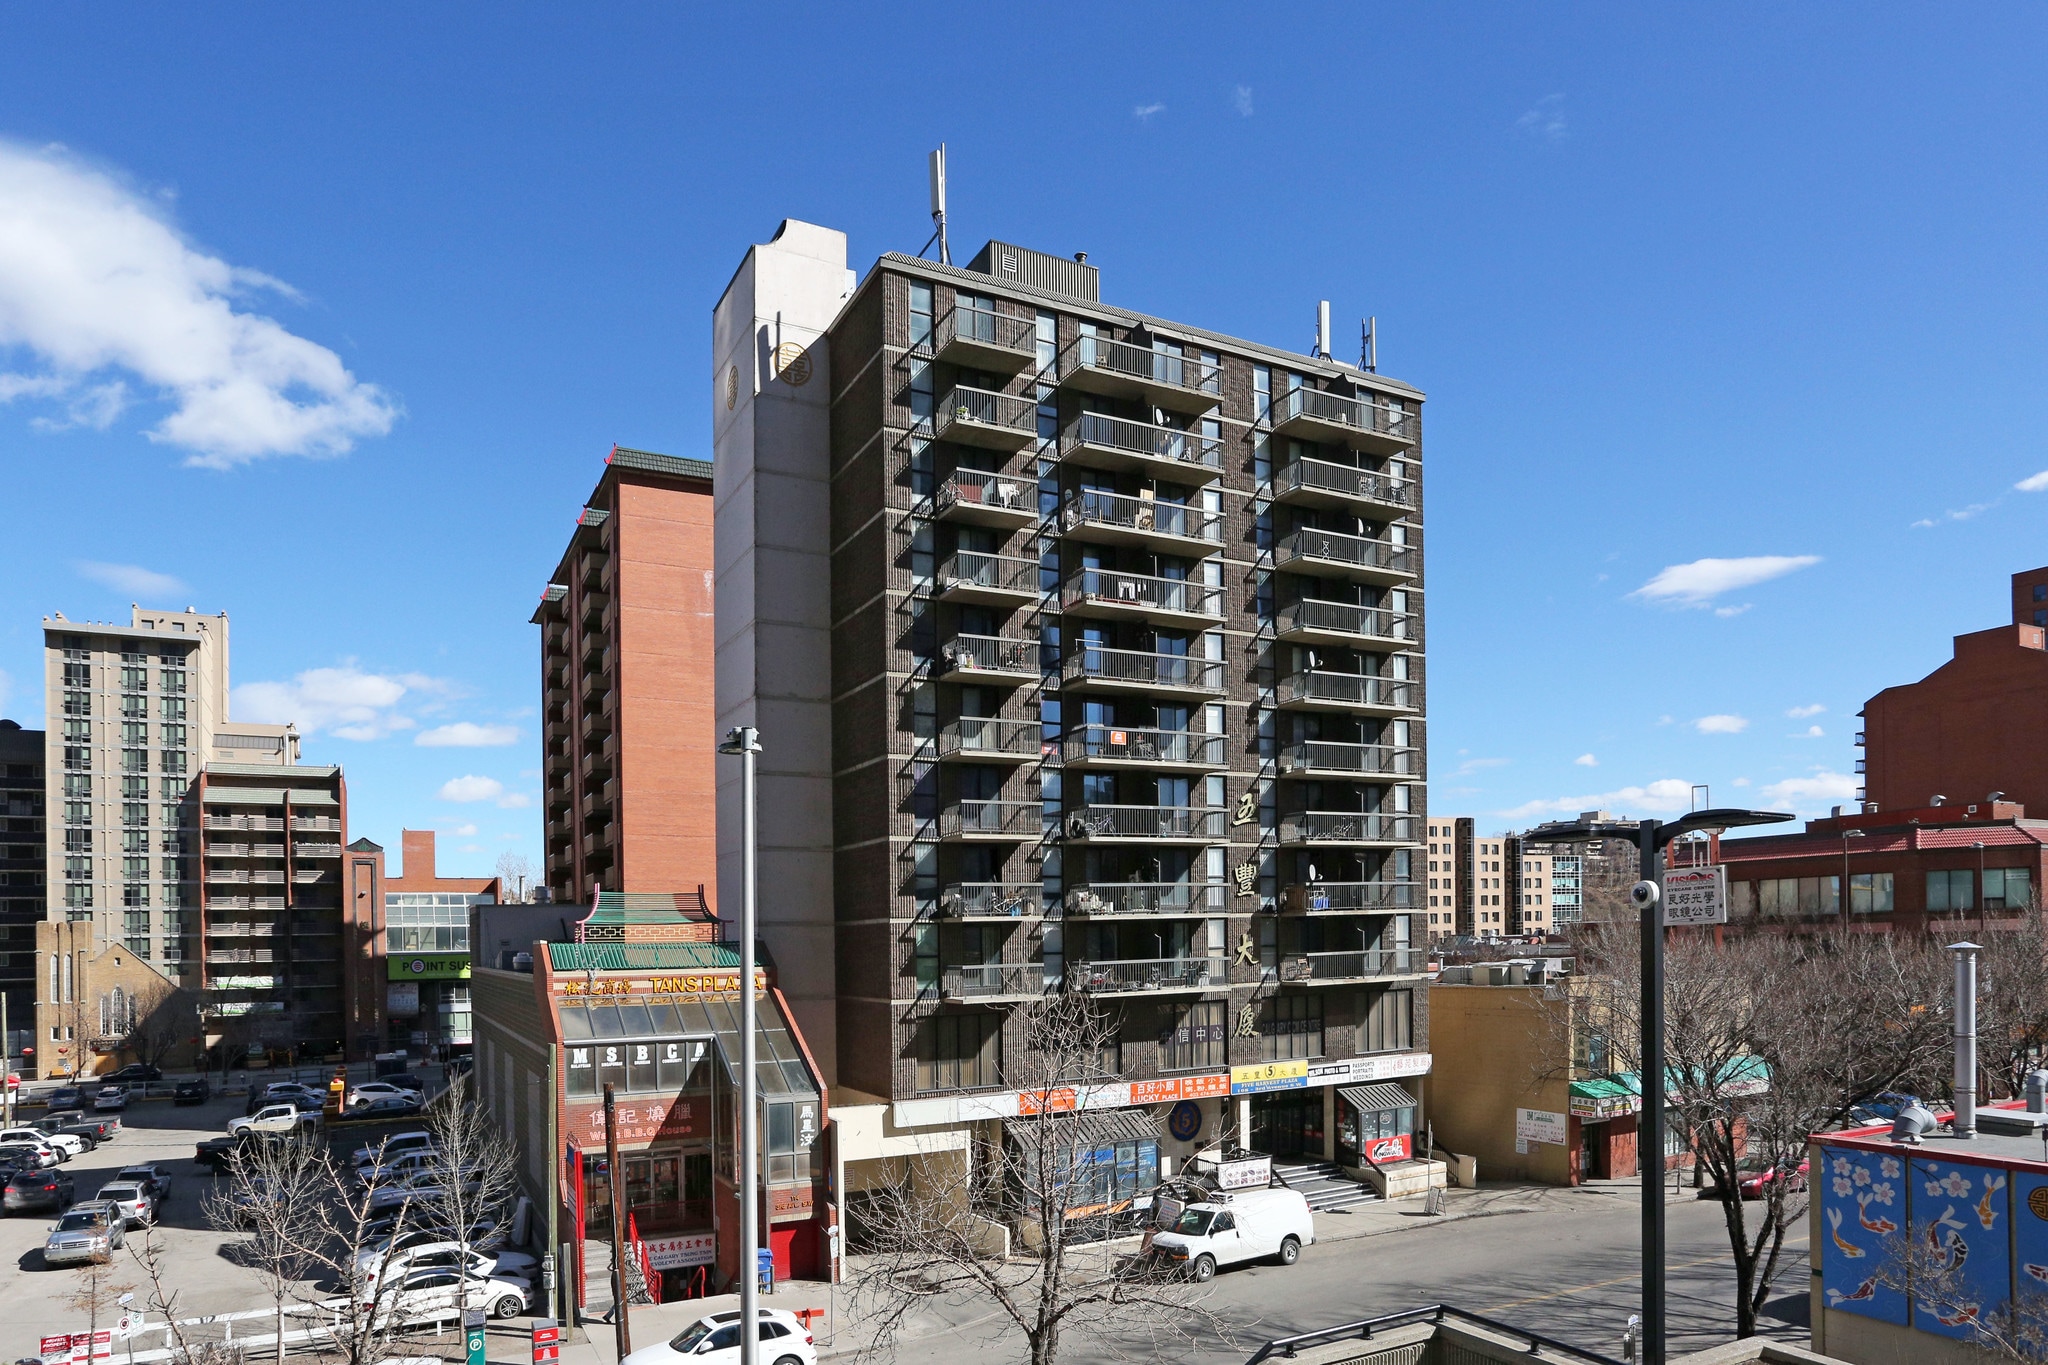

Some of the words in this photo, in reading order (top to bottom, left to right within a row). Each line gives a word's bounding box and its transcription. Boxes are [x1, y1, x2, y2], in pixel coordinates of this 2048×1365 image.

[1667, 872, 1714, 883] VISIONS
[1233, 793, 1259, 1038] 五豐大廈
[1668, 905, 1715, 918] 眼鏡公司
[650, 977, 699, 993] TANS
[702, 975, 762, 991] PLAA
[572, 1048, 588, 1063] M
[606, 1046, 617, 1062] S
[637, 1045, 648, 1060] B
[667, 1043, 677, 1059] C
[1133, 1094, 1160, 1102] LUCKY
[657, 1125, 692, 1136] House
[677, 1255, 713, 1263] ASSOCIATION
